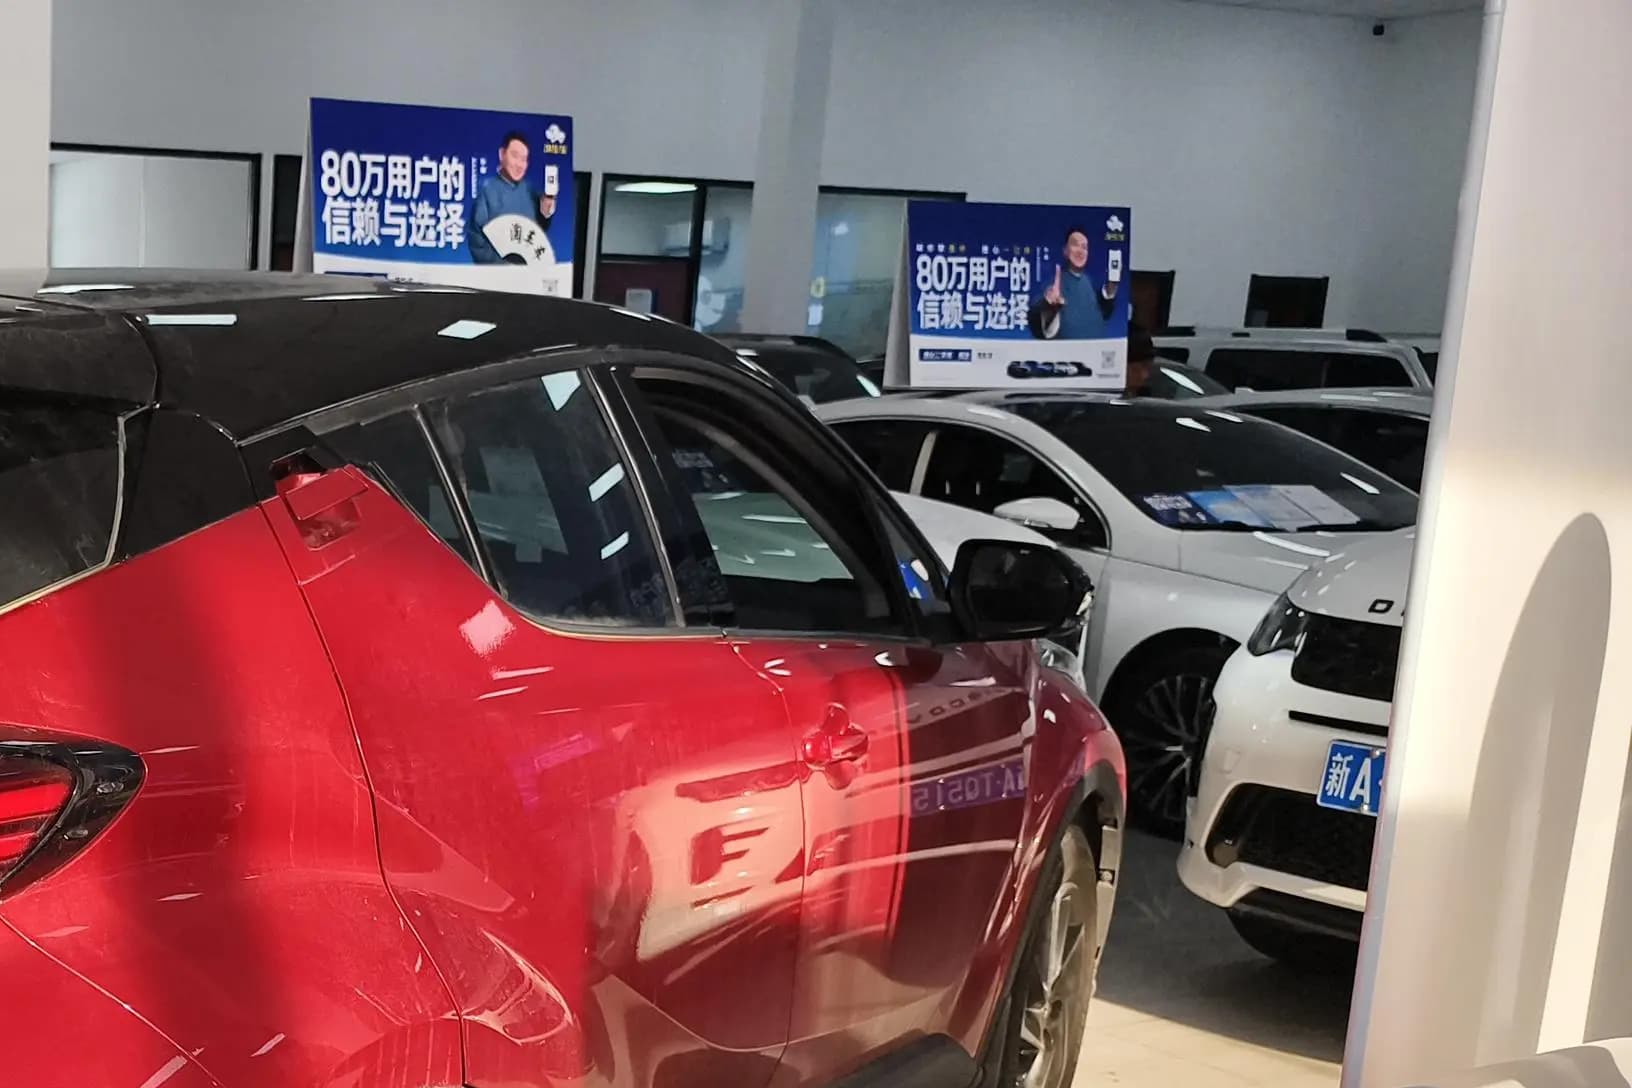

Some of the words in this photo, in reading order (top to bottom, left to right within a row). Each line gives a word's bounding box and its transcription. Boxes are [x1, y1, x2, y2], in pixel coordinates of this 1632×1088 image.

[320, 149, 464, 201] 80万用户的
[321, 196, 465, 249] 信赖与选择
[916, 255, 1031, 292] 80万用户的
[917, 291, 1030, 330] 信赖与选择
